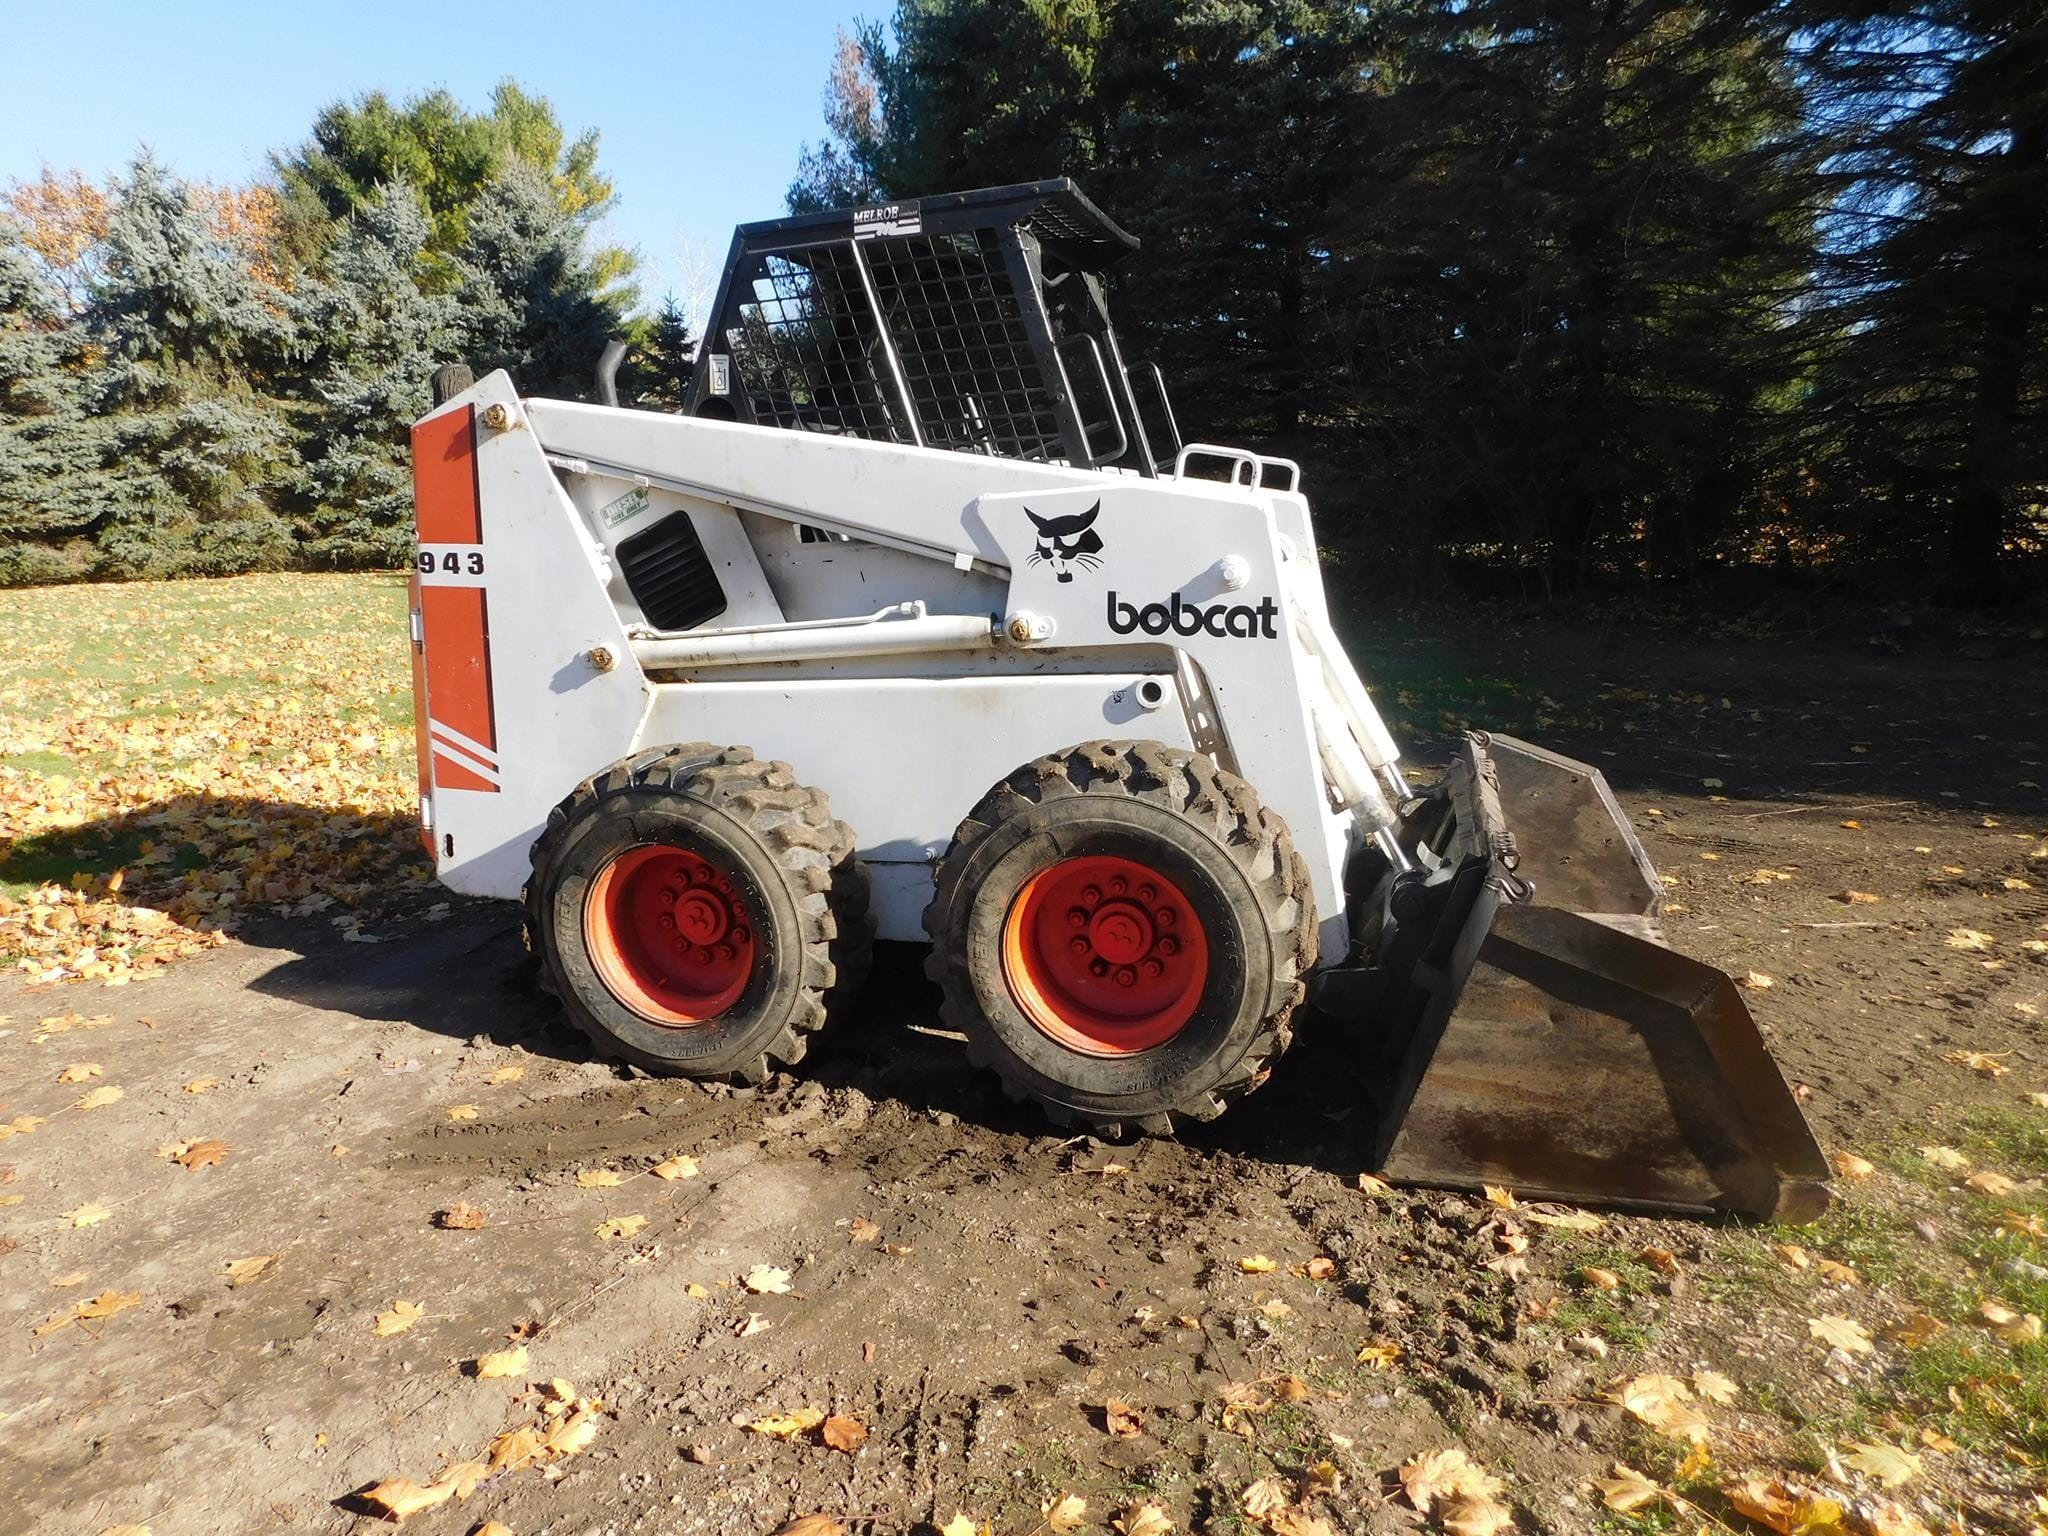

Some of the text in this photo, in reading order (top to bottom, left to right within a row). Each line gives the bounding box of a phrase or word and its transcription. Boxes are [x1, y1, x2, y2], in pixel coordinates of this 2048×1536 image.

[854, 206, 899, 224] MELROE
[419, 552, 484, 575] 943
[1107, 591, 1278, 639] bobcat
